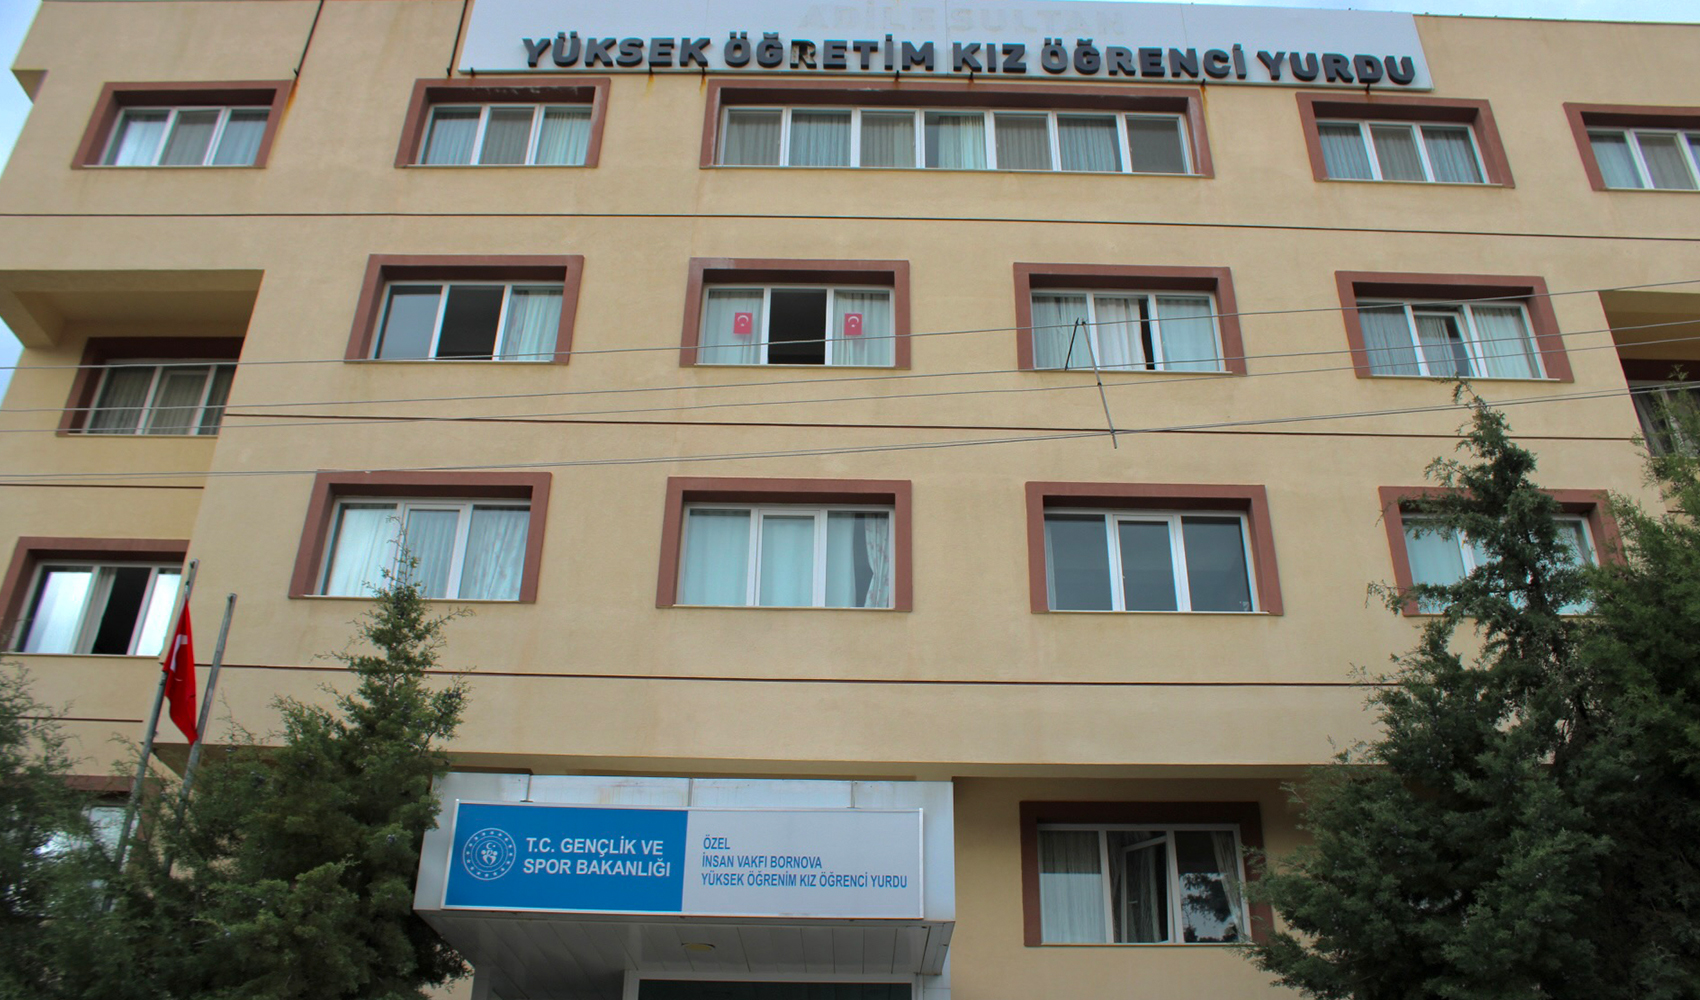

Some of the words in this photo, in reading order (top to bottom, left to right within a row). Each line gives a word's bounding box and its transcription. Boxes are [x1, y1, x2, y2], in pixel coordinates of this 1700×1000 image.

[522, 31, 710, 67] YÜKSEK
[724, 31, 935, 71] ÖĞRETİM
[952, 41, 1027, 73] KIZ
[1041, 38, 1247, 79] ÖĞRENCİ
[1257, 50, 1416, 85] YURDU
[526, 837, 555, 853] T.C.
[560, 836, 637, 857] GENÇLİK
[641, 840, 664, 855] VE
[703, 834, 731, 850] ÖZEL
[523, 858, 571, 874] SPOR
[576, 857, 671, 877] BAKANLIĞI
[702, 852, 734, 868] İNSAN
[737, 855, 767, 868] VAKFI
[770, 856, 822, 869] BORNOVA
[701, 871, 744, 886] YÜKSEK
[747, 871, 797, 887] ÖĞRENİM
[799, 874, 817, 887] KIZ
[819, 871, 868, 888] ÖĞRENCİ
[870, 875, 908, 888] YURDU
